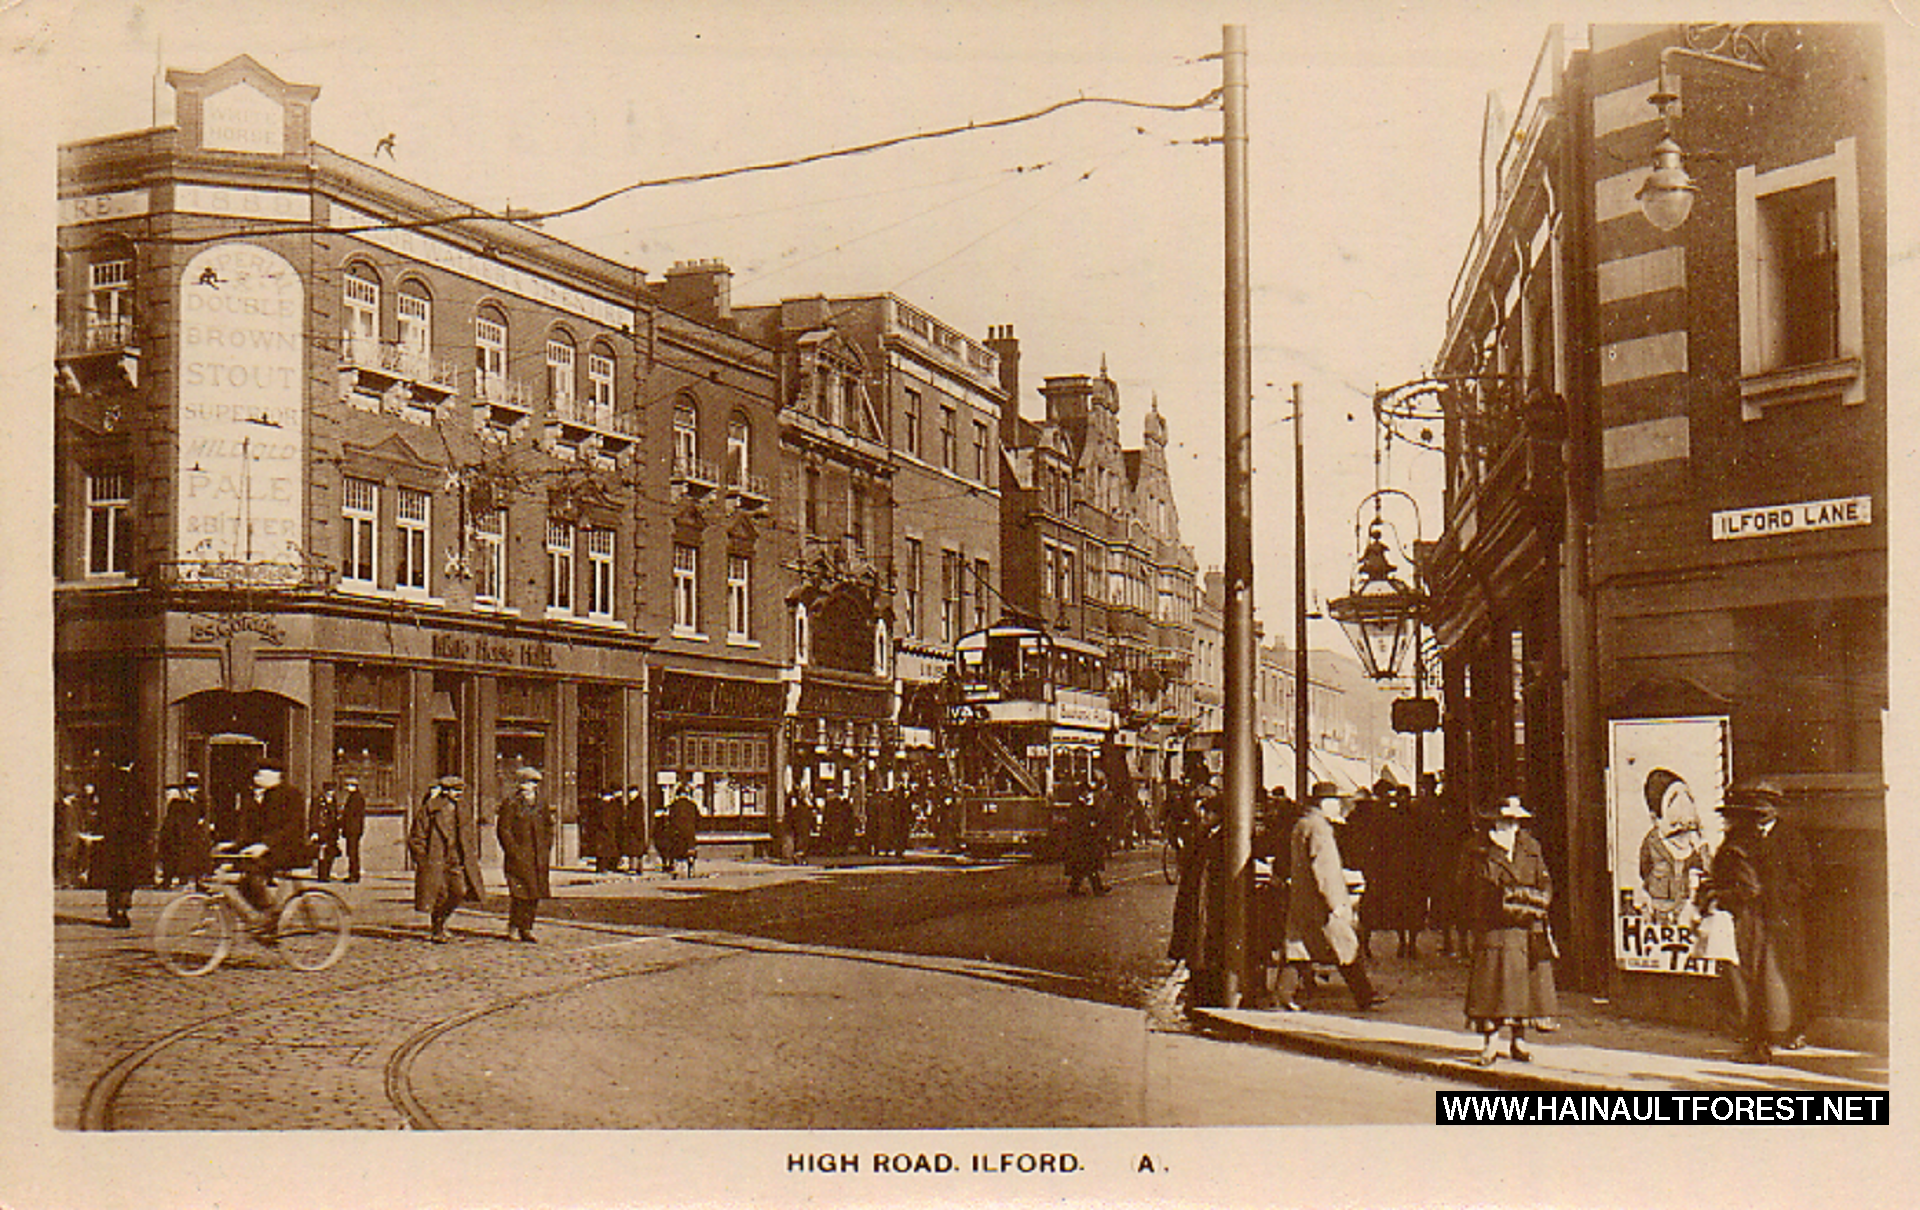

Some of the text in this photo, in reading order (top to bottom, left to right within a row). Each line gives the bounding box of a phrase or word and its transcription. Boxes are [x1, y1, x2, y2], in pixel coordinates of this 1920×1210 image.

[209, 127, 277, 145] HORSE
[186, 293, 295, 319] DOUBLE
[186, 326, 297, 352] BROWN
[186, 361, 297, 390] STOUT
[185, 403, 299, 427] SUPERIOR
[187, 474, 293, 502] PALE
[1721, 503, 1858, 533] ILFORD LANE
[1622, 917, 1695, 957] HARR
[1660, 943, 1719, 974] TAT
